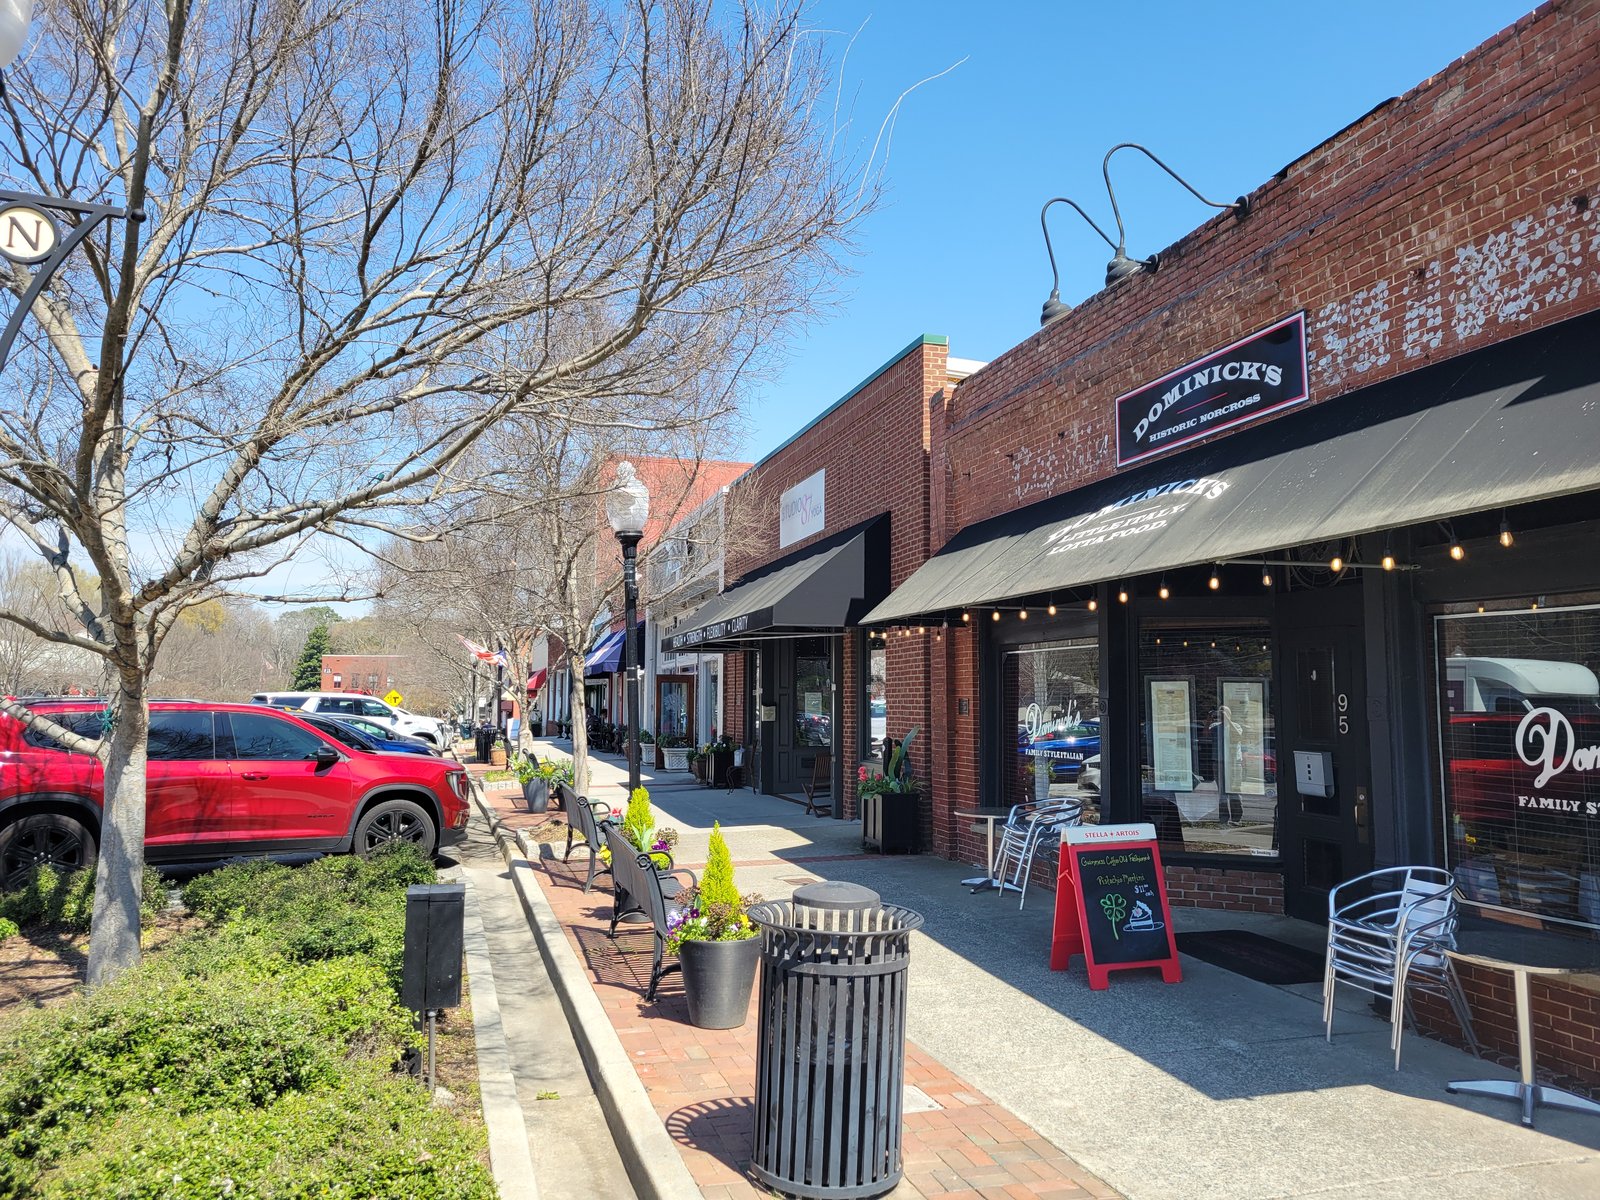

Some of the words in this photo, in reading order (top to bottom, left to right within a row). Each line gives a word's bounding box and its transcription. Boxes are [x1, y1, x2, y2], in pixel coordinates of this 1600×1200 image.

[6, 216, 43, 252] N
[1132, 361, 1283, 443] DOMINICK'S
[1149, 418, 1198, 443] HISTORIC
[1199, 393, 1261, 423] NORCROSS
[800, 493, 813, 526] 87
[1058, 520, 1123, 543] LITTLE
[1046, 534, 1106, 556] LOTTA
[706, 622, 727, 640] FLEXIBILITY
[731, 615, 749, 633] CLARITY
[1025, 748, 1044, 757] FAMILY
[1043, 750, 1060, 759] STYLE
[1060, 751, 1084, 761] ITALIAN
[1518, 796, 1581, 812] FAMILY
